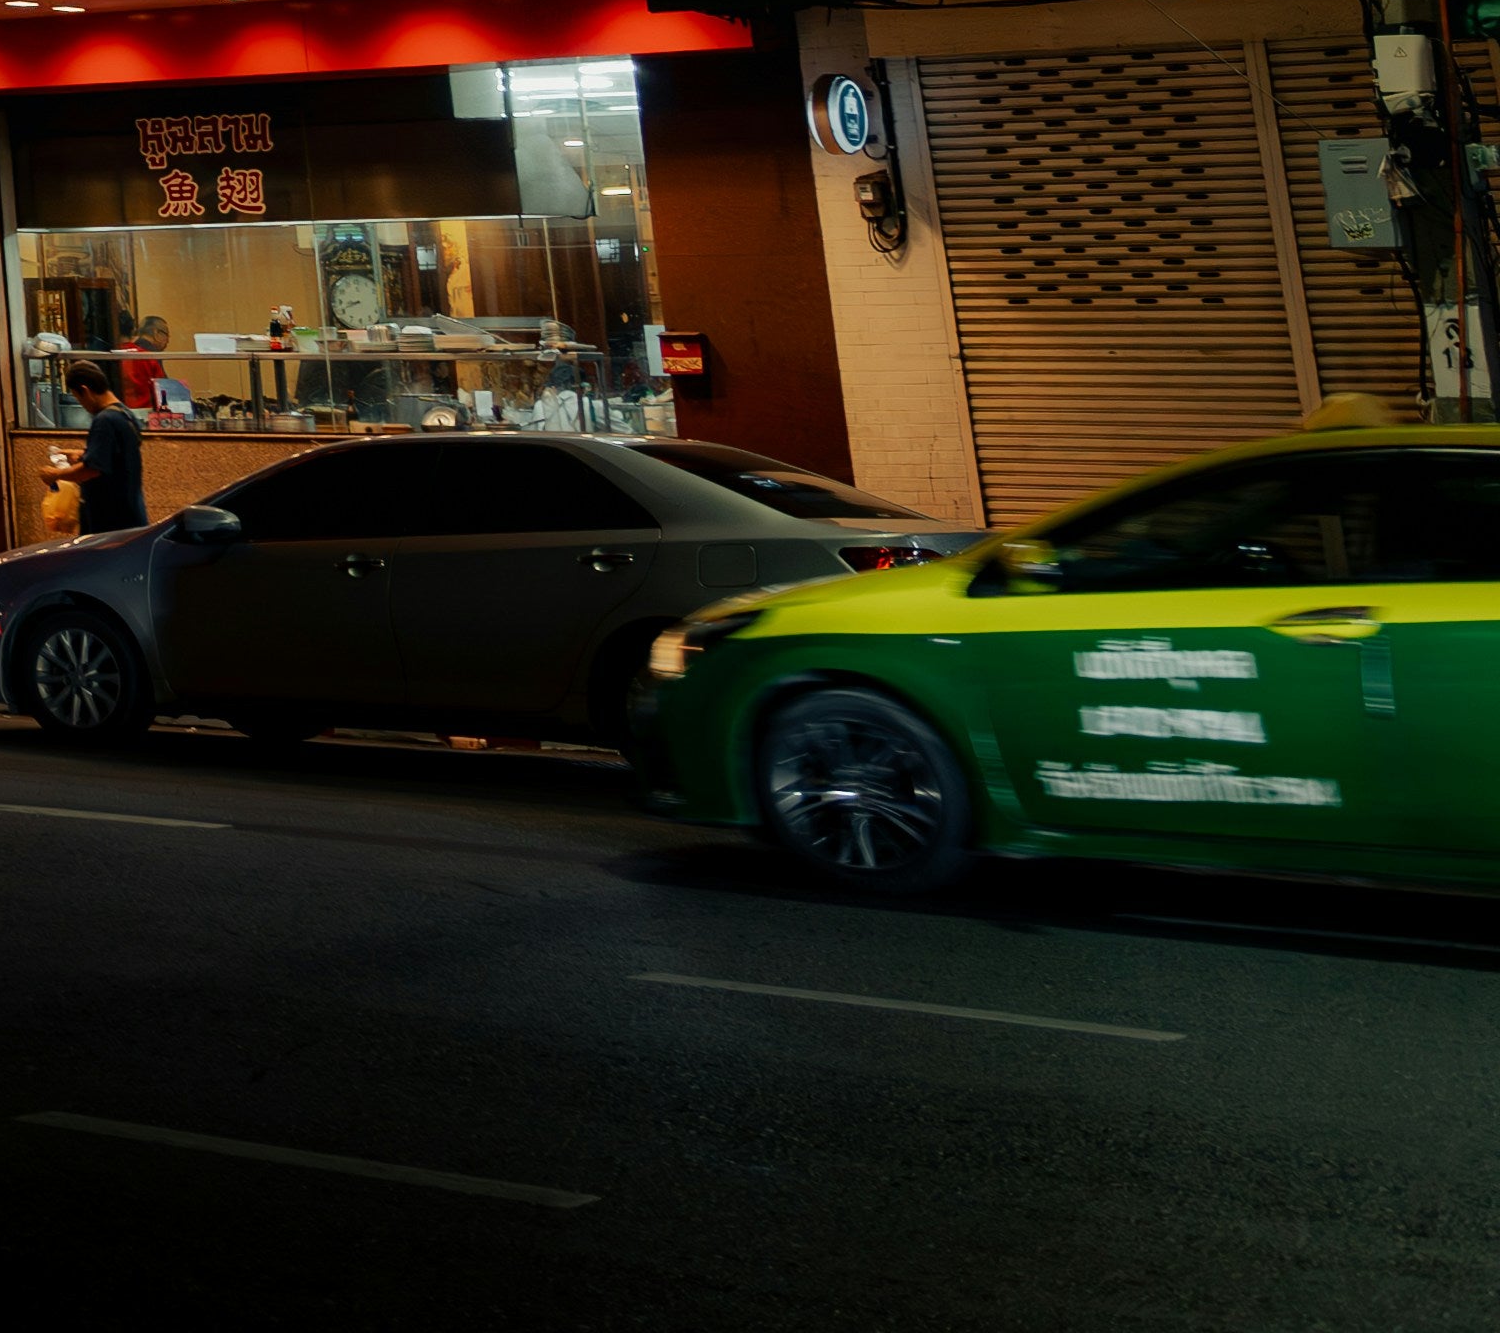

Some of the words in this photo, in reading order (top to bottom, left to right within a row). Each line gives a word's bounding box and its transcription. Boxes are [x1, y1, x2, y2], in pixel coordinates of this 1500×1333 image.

[134, 112, 276, 170] หูฉลาม
[158, 167, 267, 217] 魚翅
